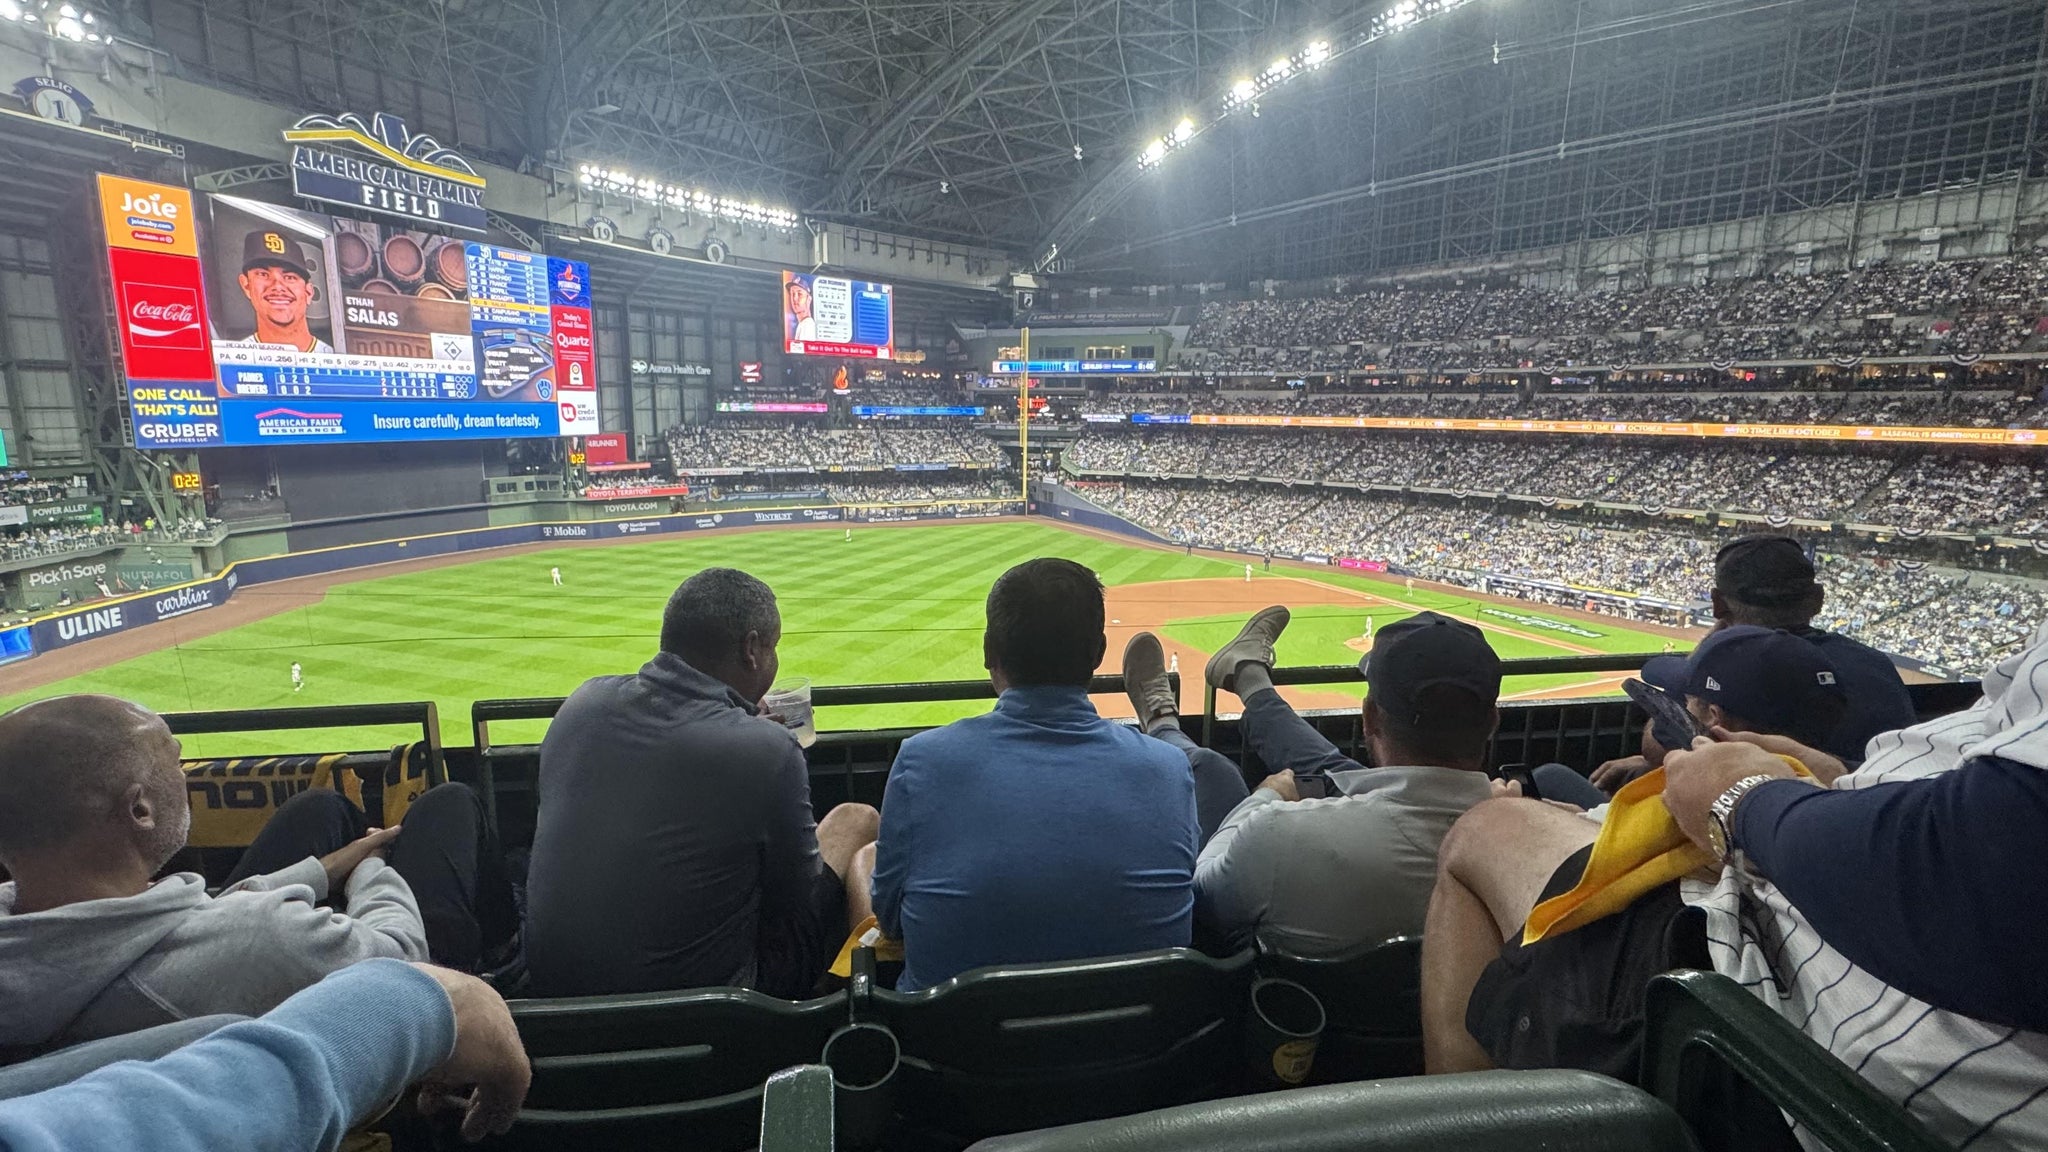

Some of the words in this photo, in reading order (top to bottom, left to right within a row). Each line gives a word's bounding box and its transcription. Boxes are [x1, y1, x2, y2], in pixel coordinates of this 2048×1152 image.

[34, 77, 73, 94] SELIG
[52, 100, 68, 121] 1
[293, 145, 410, 191] AMERICAN
[416, 177, 485, 209] FAMILY
[120, 192, 178, 219] Joie
[362, 186, 440, 219] FIELD
[597, 226, 611, 240] 19
[656, 238, 663, 250] 4
[345, 296, 375, 308] ETHAN
[133, 300, 195, 322] Coca-Cola
[347, 307, 399, 327] SALAS
[557, 333, 590, 348] Quartz
[648, 363, 672, 374] Aurora
[673, 364, 695, 375] Health
[695, 365, 711, 375] Care
[280, 375, 285, 383] 0
[292, 375, 298, 384] 2
[304, 375, 310, 384] 0
[381, 378, 386, 386] 2
[133, 388, 168, 401] ONE
[281, 385, 287, 395] 0
[293, 386, 300, 395] 0
[305, 386, 312, 395] 2
[382, 388, 388, 397] 2
[134, 404, 187, 416] THAT'S
[188, 404, 218, 416] ALL!
[258, 418, 308, 427] AMERICAN
[310, 418, 342, 427] FAMILY
[373, 413, 411, 429] Insure
[413, 413, 462, 431] carefully,
[464, 413, 494, 428] dream
[496, 413, 541, 429] fearlessly.
[139, 423, 219, 438] GRUBER
[1751, 427, 1772, 435] TIME
[1796, 428, 1841, 437] OCTOBER
[1881, 430, 1920, 438] BASEBALL
[1931, 431, 1980, 440] SOMETHING
[1981, 432, 2004, 441] ELSE
[588, 439, 618, 448] 4RUNNER
[589, 490, 616, 498] TOYOTA
[616, 488, 652, 496] TERRITORY
[32, 506, 62, 517] POWER
[63, 503, 88, 514] ALLEY
[604, 502, 658, 513] TOYOTA.COM
[754, 511, 793, 521] WINTRUST
[554, 525, 586, 536] Mobile
[73, 563, 106, 577] Save
[122, 570, 187, 581] NUTRAFOL
[156, 587, 211, 614] carbliss
[57, 606, 123, 640] ULINE
